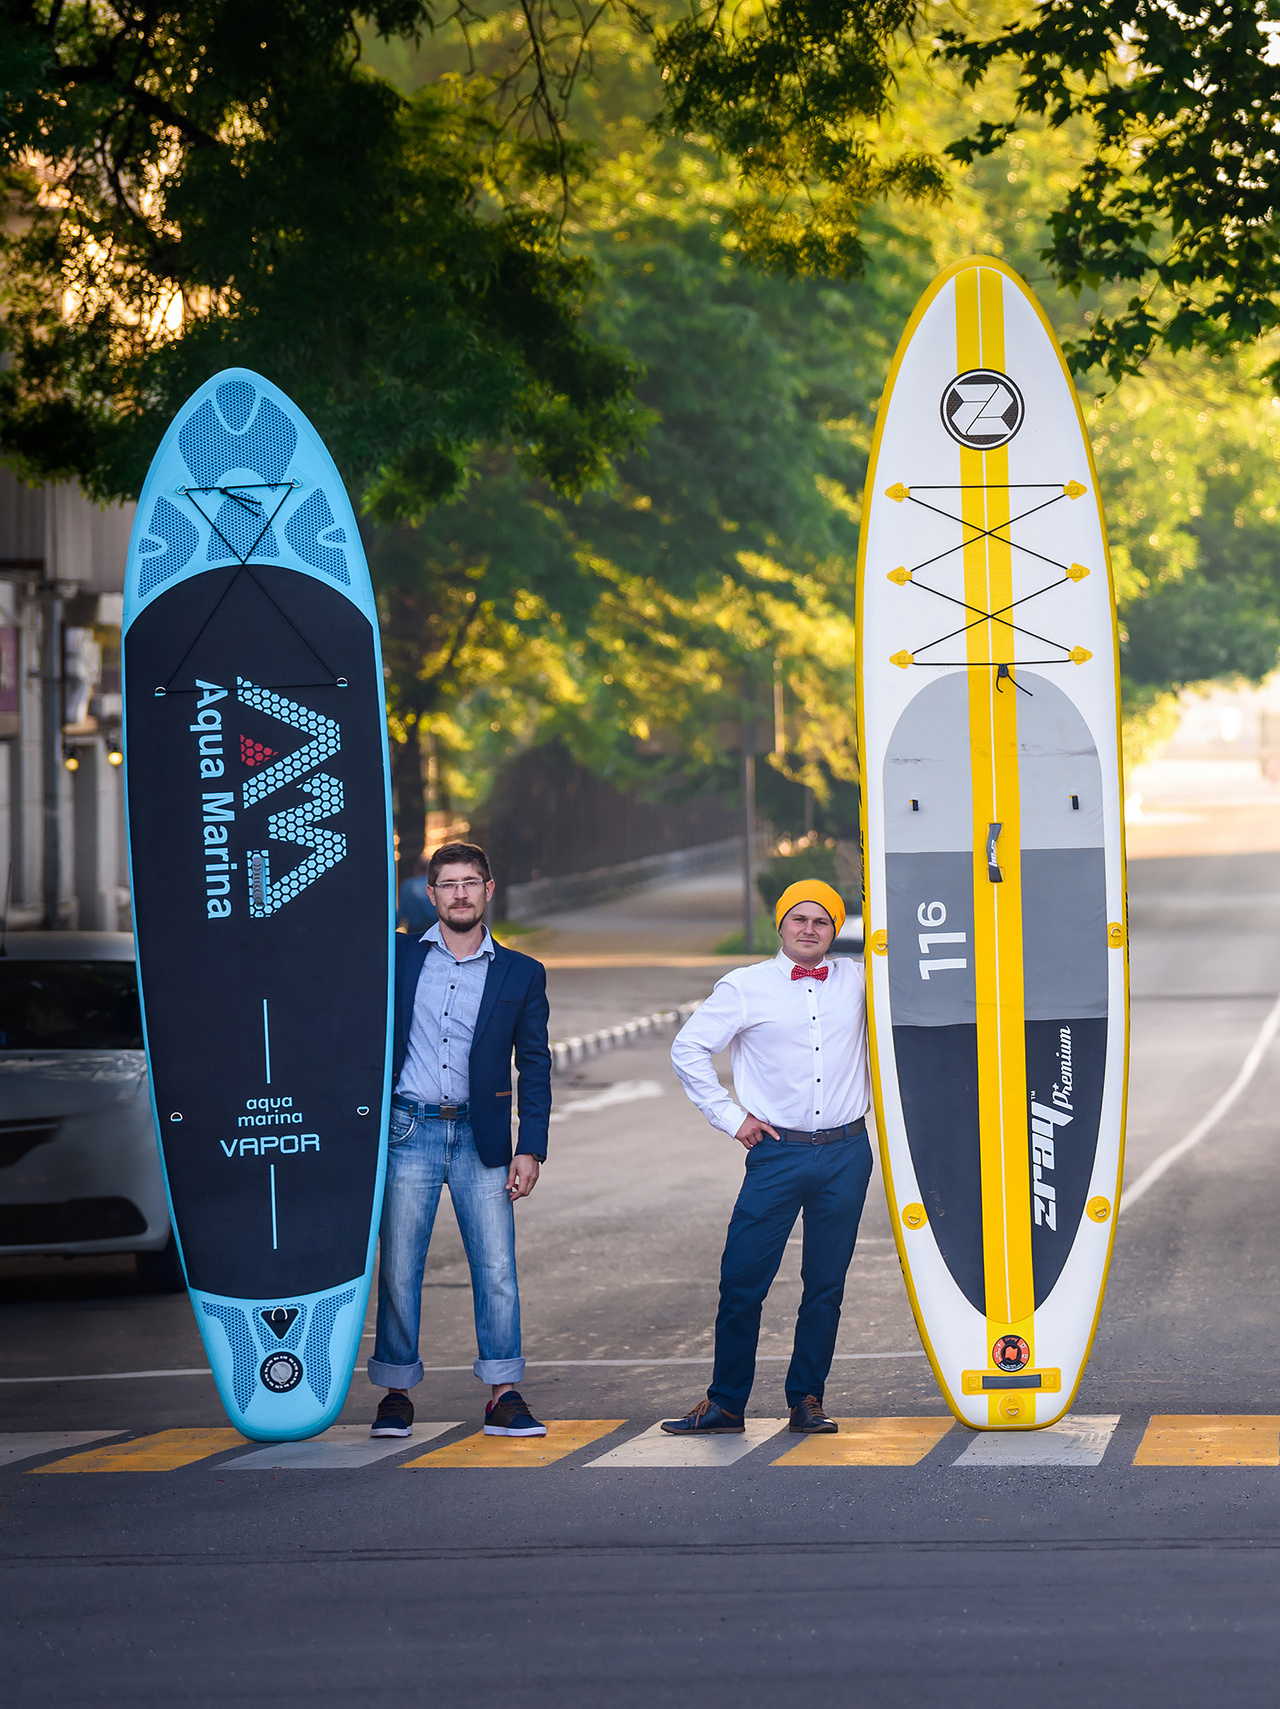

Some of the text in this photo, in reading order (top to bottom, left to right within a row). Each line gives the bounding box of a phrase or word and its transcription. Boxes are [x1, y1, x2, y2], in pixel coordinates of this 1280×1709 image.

[189, 678, 239, 919] Aqua Marina
[246, 1096, 293, 1113] aqua
[237, 1109, 303, 1127] marina
[220, 1133, 320, 1158] VAPOR
